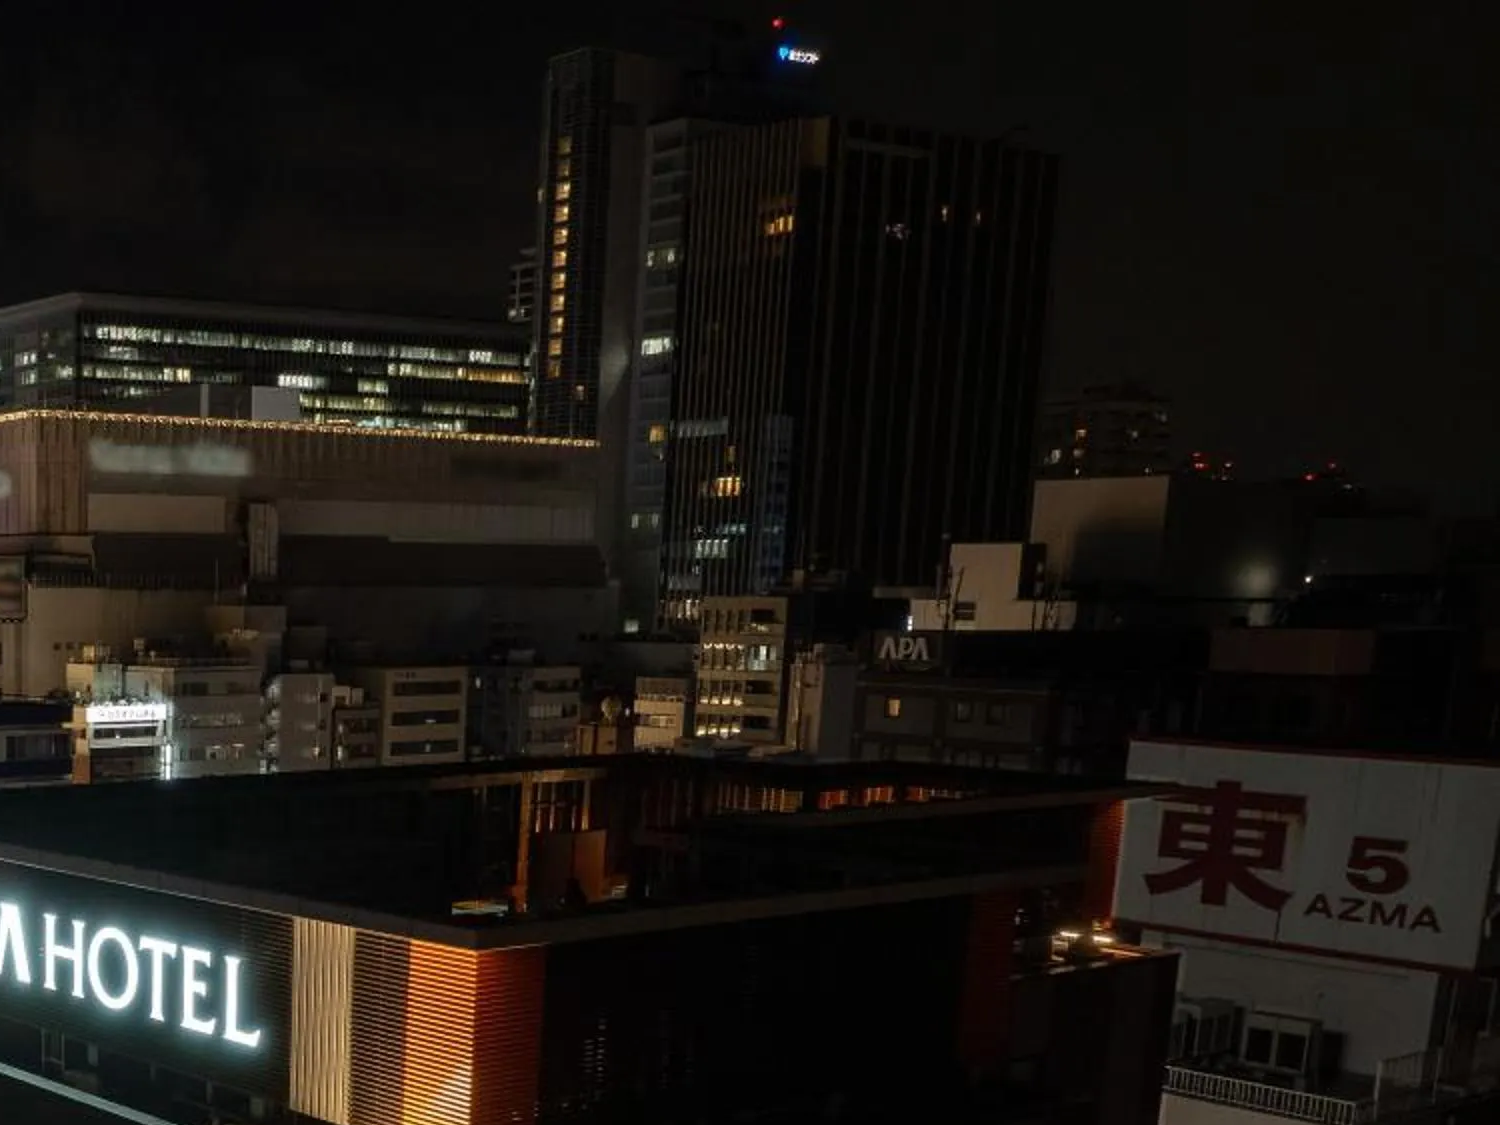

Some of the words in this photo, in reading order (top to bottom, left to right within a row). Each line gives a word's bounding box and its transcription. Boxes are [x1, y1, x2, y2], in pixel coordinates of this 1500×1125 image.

[879, 636, 929, 660] APA
[1143, 781, 1307, 910] 東
[1346, 836, 1409, 894] 5
[1304, 894, 1442, 932] AZMA
[43, 911, 262, 1048] HOTEL
